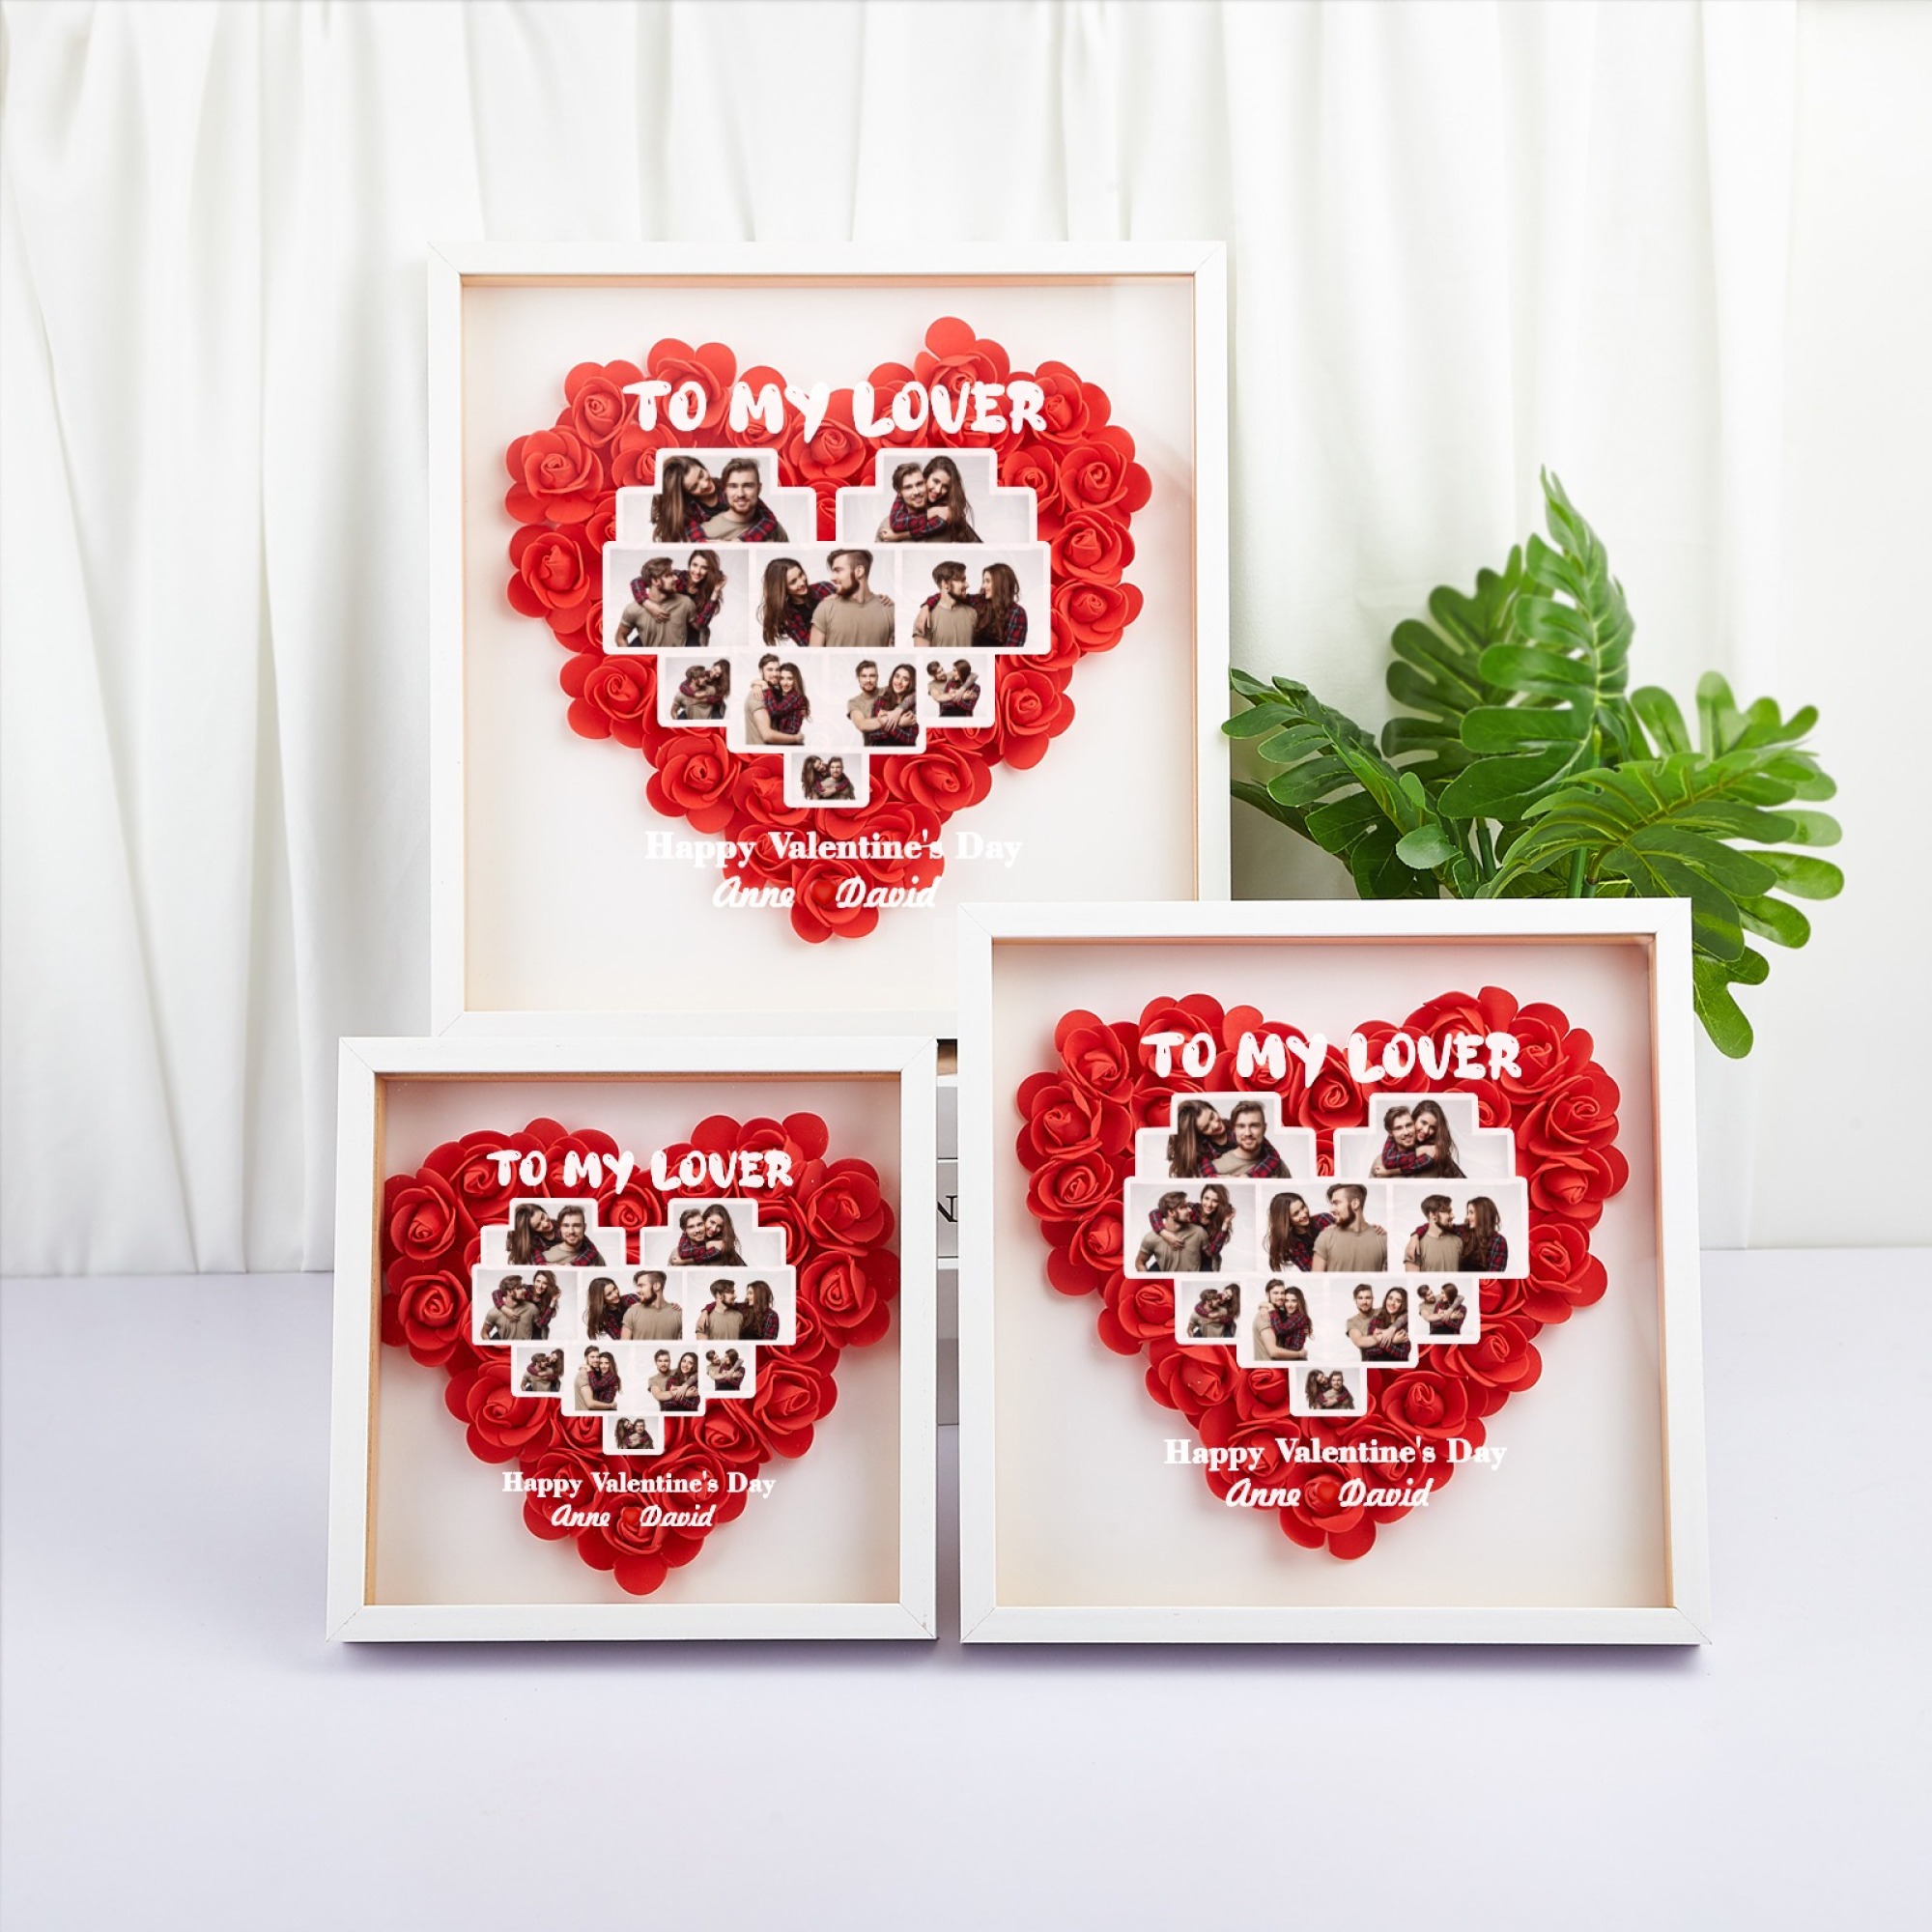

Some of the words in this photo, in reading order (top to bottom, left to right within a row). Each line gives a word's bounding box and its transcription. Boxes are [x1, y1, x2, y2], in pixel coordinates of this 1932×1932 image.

[622, 381, 707, 432] TO
[729, 381, 830, 443] MY
[852, 381, 1047, 438] LOVER
[644, 832, 756, 869] Happy
[769, 830, 944, 861] Valentine's
[956, 832, 1023, 867] Day
[713, 875, 795, 909] Anne
[836, 875, 942, 909] David
[1141, 1032, 1216, 1078] TO
[1236, 1032, 1327, 1088] MY
[1347, 1032, 1521, 1083] LOVER
[486, 1150, 547, 1186] TO
[563, 1150, 635, 1195] MY
[651, 1150, 793, 1191] LOVER
[1164, 1438, 1264, 1471] Happy
[1275, 1435, 1435, 1463] Valentine's
[1446, 1438, 1507, 1470] Day
[502, 1472, 582, 1498] Happy
[591, 1471, 719, 1493] Valentine's
[727, 1472, 776, 1498] Day
[1225, 1478, 1300, 1508] Anne
[1338, 1478, 1434, 1508] David
[551, 1504, 611, 1527] Anne
[639, 1504, 716, 1527] David
